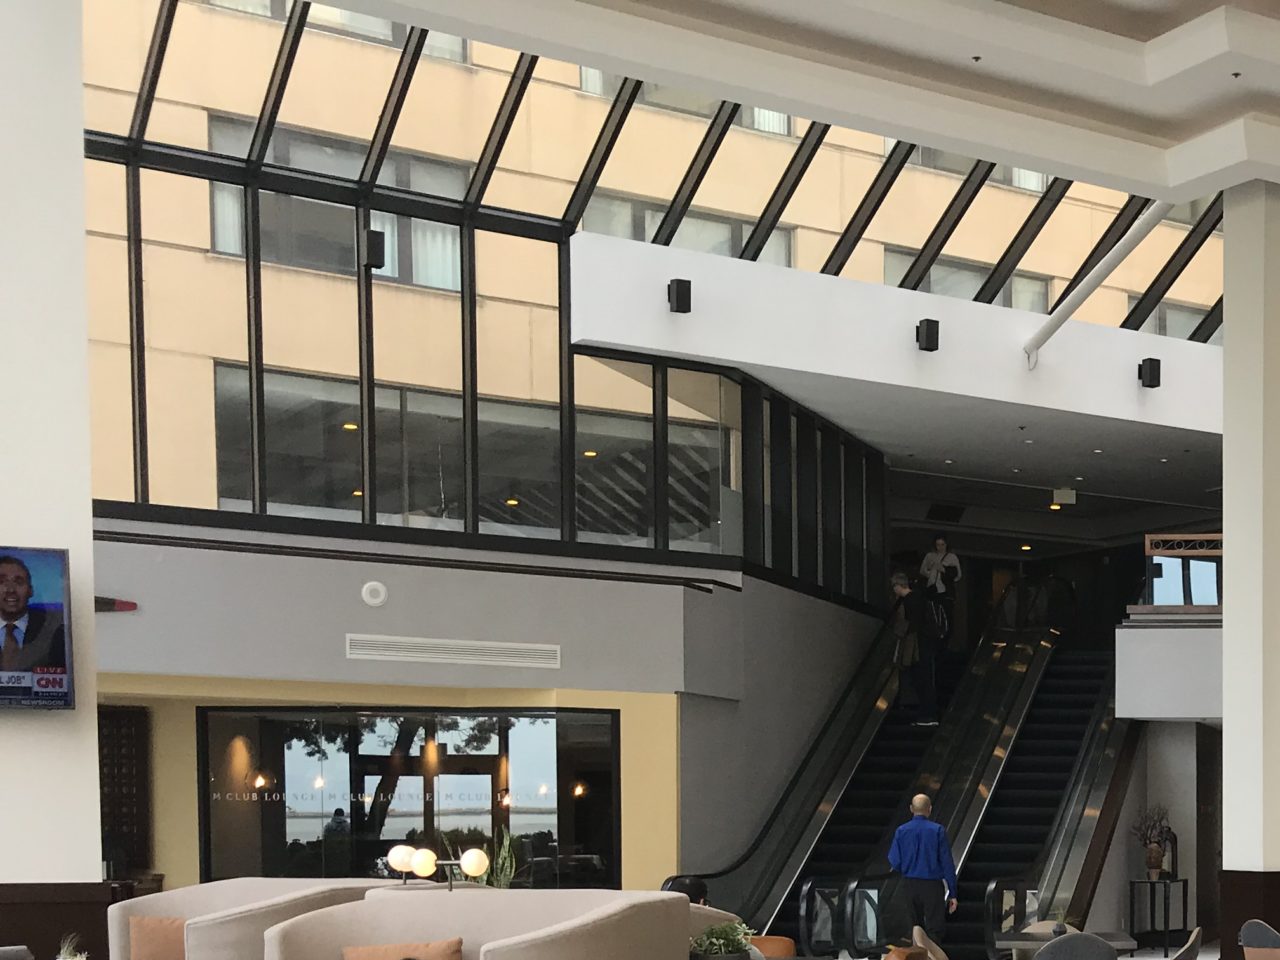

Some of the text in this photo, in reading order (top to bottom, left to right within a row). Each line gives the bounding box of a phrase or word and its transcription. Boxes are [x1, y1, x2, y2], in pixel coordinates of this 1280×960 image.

[36, 677, 64, 689] CNN
[212, 793, 222, 801] M
[226, 793, 258, 801] CLUB
